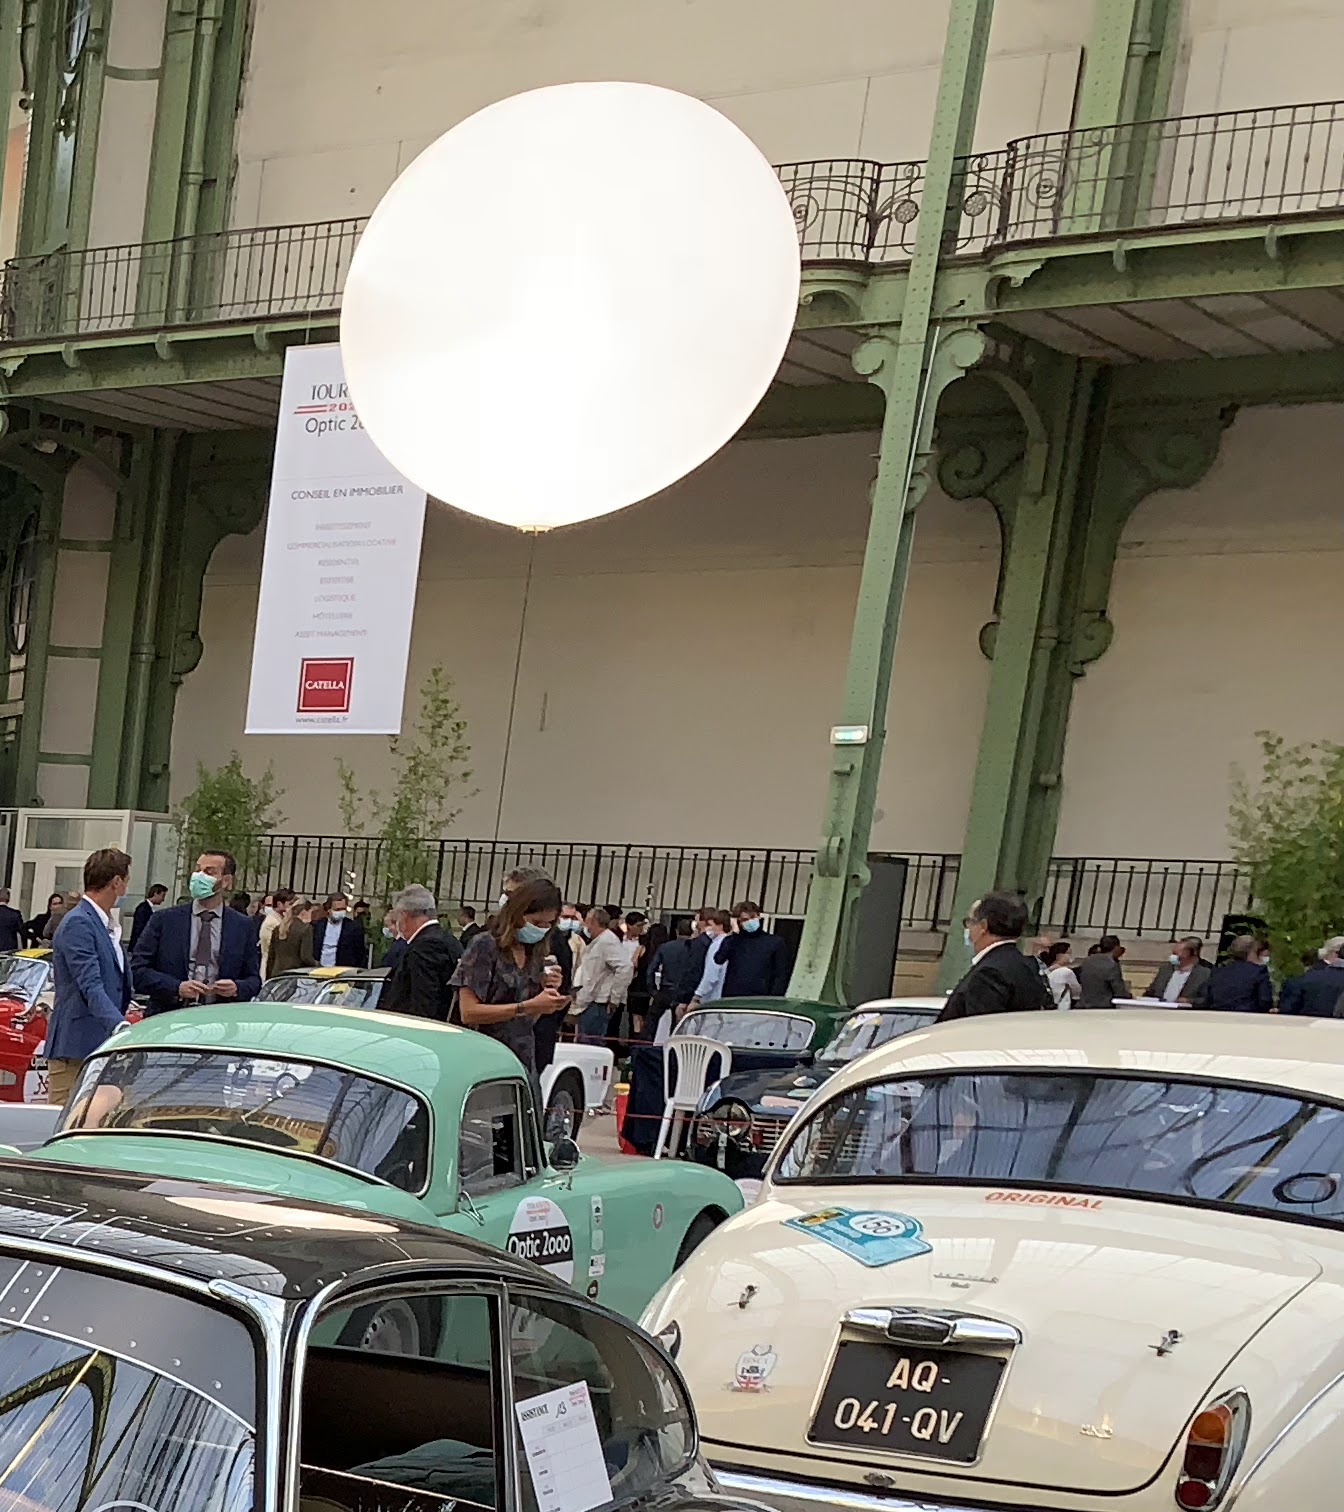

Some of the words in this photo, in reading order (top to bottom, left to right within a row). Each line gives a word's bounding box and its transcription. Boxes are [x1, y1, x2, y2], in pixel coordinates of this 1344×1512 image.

[312, 383, 349, 401] TOUR
[305, 415, 346, 437] Optic
[291, 489, 330, 500] CONSEIL
[333, 488, 347, 498] EN
[349, 485, 403, 497] IMMOBILIER
[305, 680, 345, 690] CATELLA
[984, 1191, 1103, 1210] ORIGINAL
[853, 1214, 900, 1235] 156
[509, 1233, 541, 1258] Optic
[542, 1231, 571, 1255] 2000
[833, 1397, 965, 1444] 041-QV
